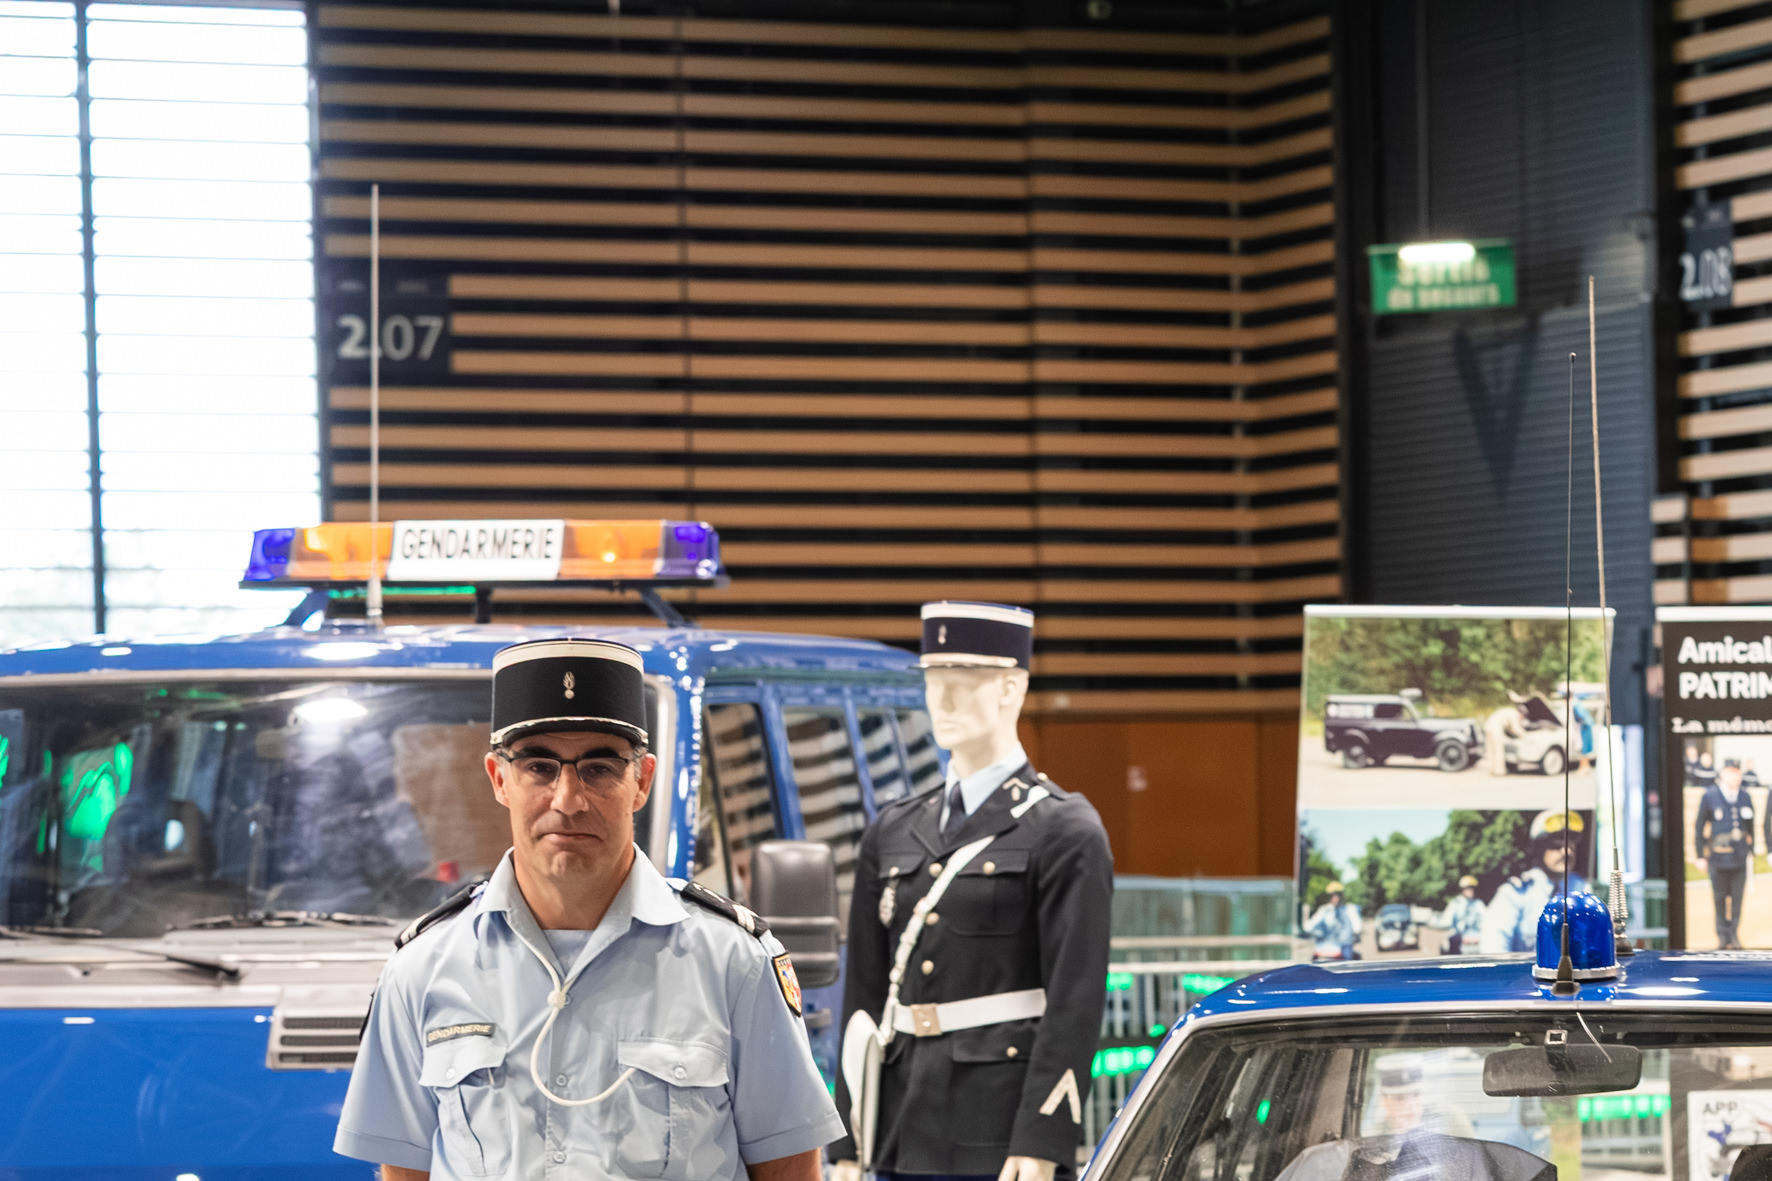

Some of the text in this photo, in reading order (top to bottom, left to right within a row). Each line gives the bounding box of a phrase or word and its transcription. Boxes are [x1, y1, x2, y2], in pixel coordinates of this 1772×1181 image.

[402, 528, 554, 559] GENDARMERIE
[1672, 716, 1704, 733] La
[427, 1024, 491, 1042] GENDARMERIE
